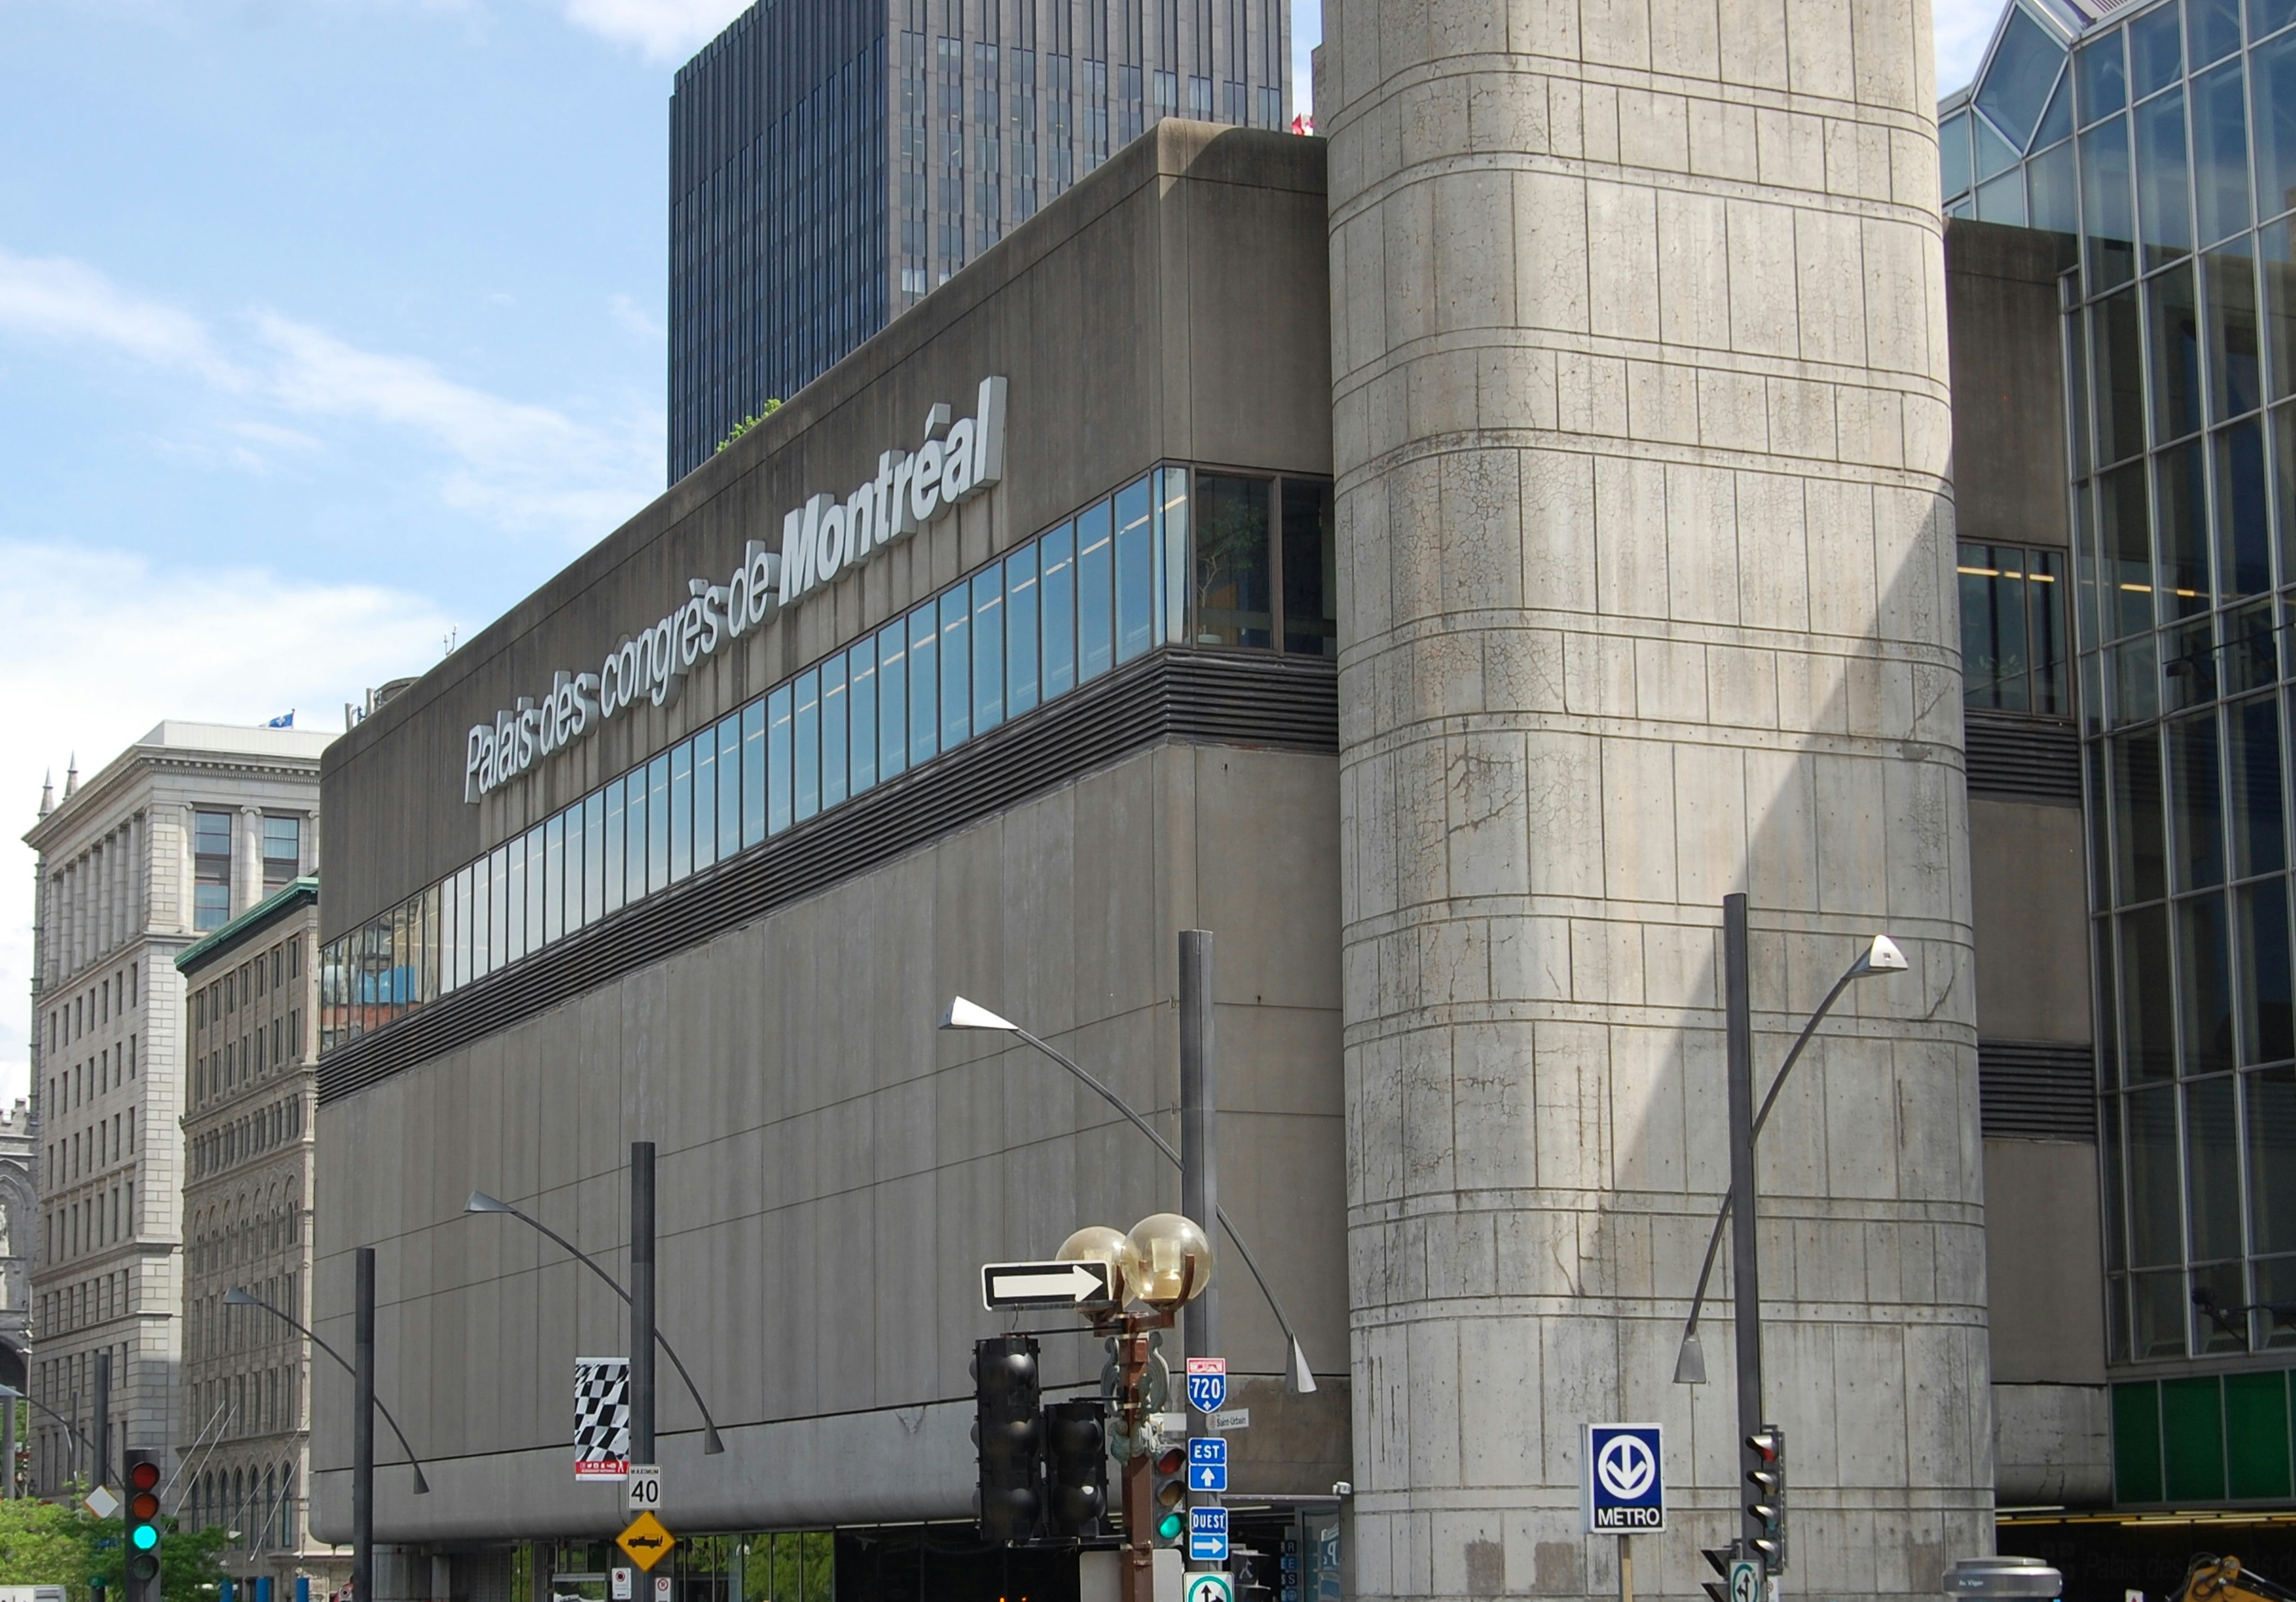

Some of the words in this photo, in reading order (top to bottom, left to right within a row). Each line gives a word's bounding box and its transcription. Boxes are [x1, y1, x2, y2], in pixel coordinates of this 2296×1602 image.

[465, 697, 538, 804] Palais
[540, 670, 599, 756] des
[601, 578, 731, 719] congrès
[728, 539, 781, 638] de
[779, 376, 1008, 608] Montréal
[1192, 1378, 1221, 1399] 720
[1194, 1445, 1220, 1459] EST
[631, 1480, 658, 1502] 40
[1193, 1514, 1224, 1528] OUEST
